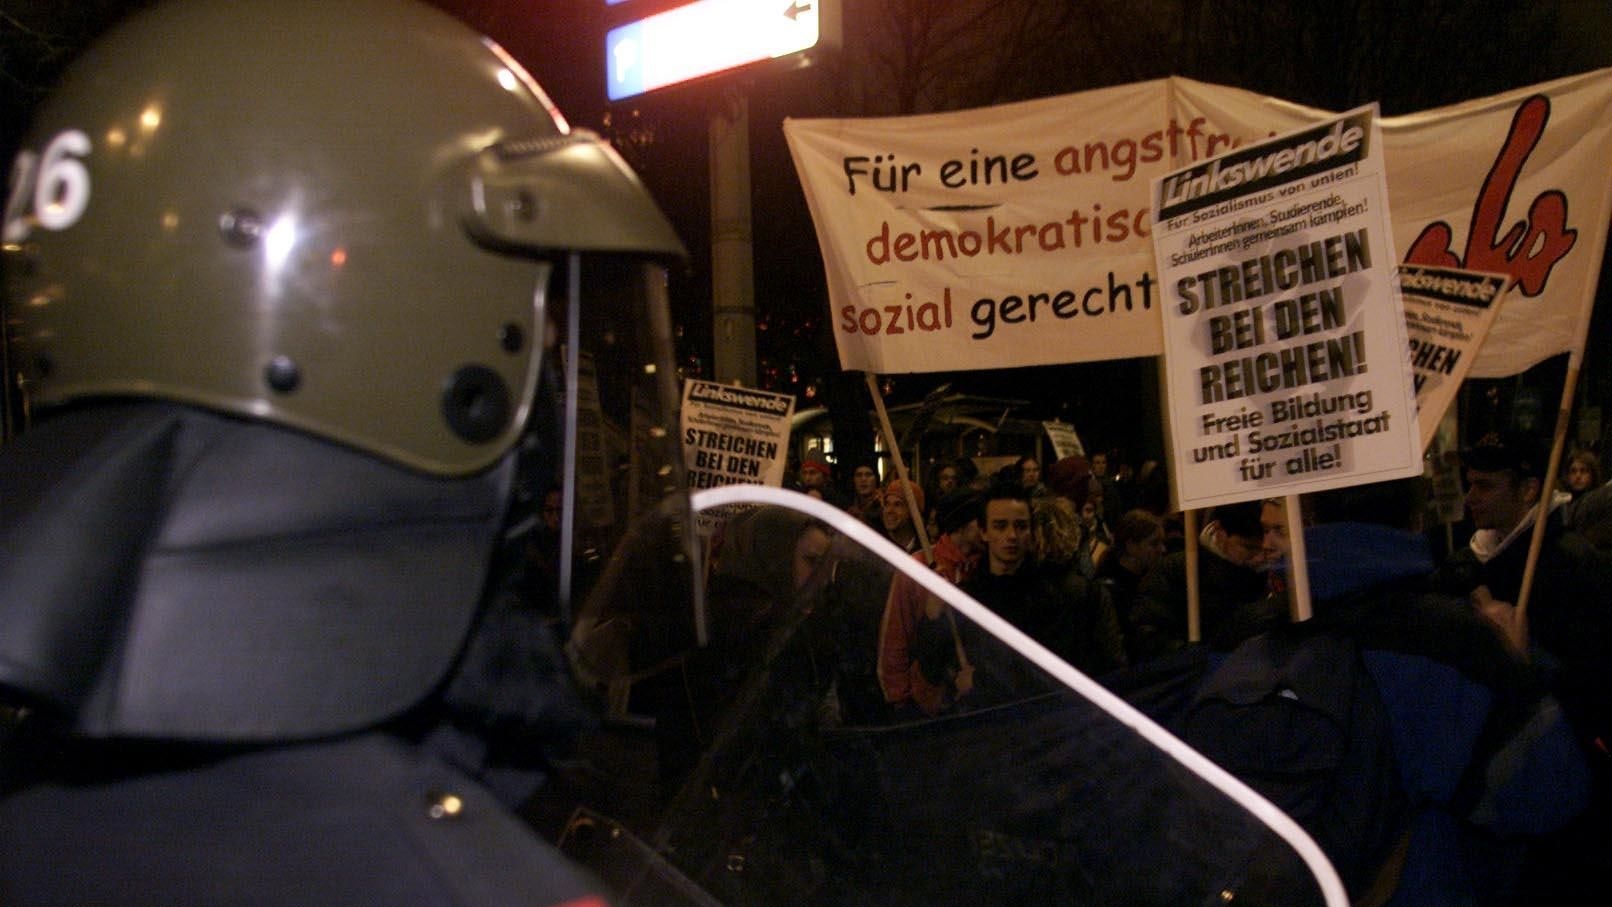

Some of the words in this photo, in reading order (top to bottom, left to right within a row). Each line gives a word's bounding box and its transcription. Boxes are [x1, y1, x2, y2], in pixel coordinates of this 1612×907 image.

[843, 154, 922, 195] Für
[939, 149, 1039, 189] eine
[1162, 119, 1365, 205] Linkswende
[1192, 190, 1273, 225] Sozialismus
[1279, 183, 1305, 198] von
[1311, 164, 1360, 190] unten!
[1243, 218, 1306, 251] gemeinsam
[1177, 227, 1373, 315] STREICHEN
[841, 288, 952, 335] sozial
[1210, 305, 1266, 356] BEI
[1274, 289, 1346, 340] DEN
[1199, 330, 1370, 405] REICHEN!
[1201, 406, 1264, 436] Freie
[1271, 390, 1374, 425] Bildung
[685, 428, 778, 461] STREICHEN
[1193, 434, 1241, 464] und
[1247, 410, 1392, 454] Sozialstaat
[695, 450, 722, 471] BEI
[727, 457, 761, 478] DEN
[1239, 457, 1278, 483] für
[1285, 443, 1343, 475] alle!
